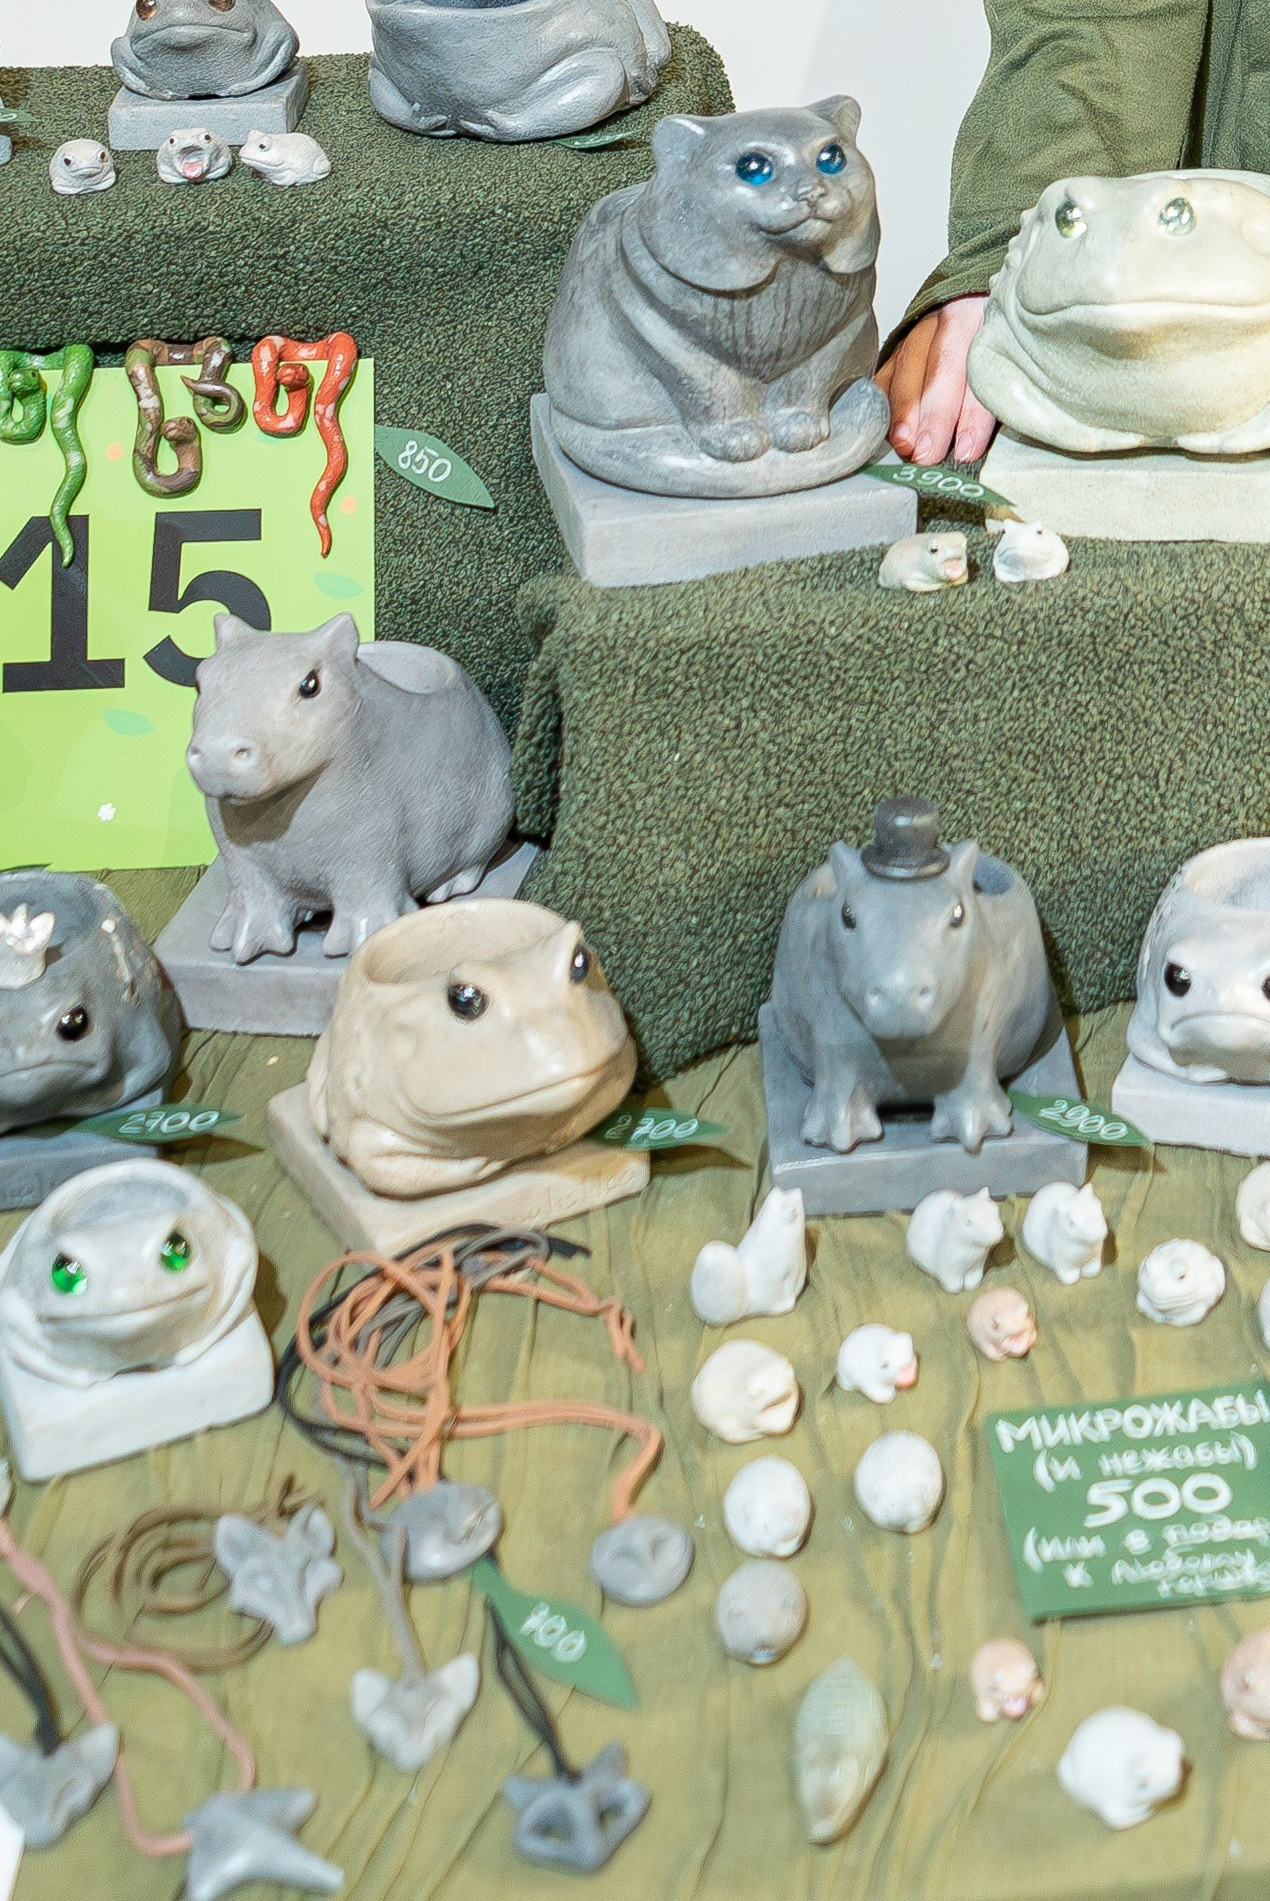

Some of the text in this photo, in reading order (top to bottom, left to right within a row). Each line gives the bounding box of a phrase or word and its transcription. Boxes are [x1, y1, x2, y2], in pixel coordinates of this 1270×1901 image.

[397, 440, 452, 483] 850
[892, 466, 985, 498] 3900
[0, 508, 272, 693] 15
[1038, 1099, 1129, 1140] 2900
[1083, 1472, 1233, 1528] 500
